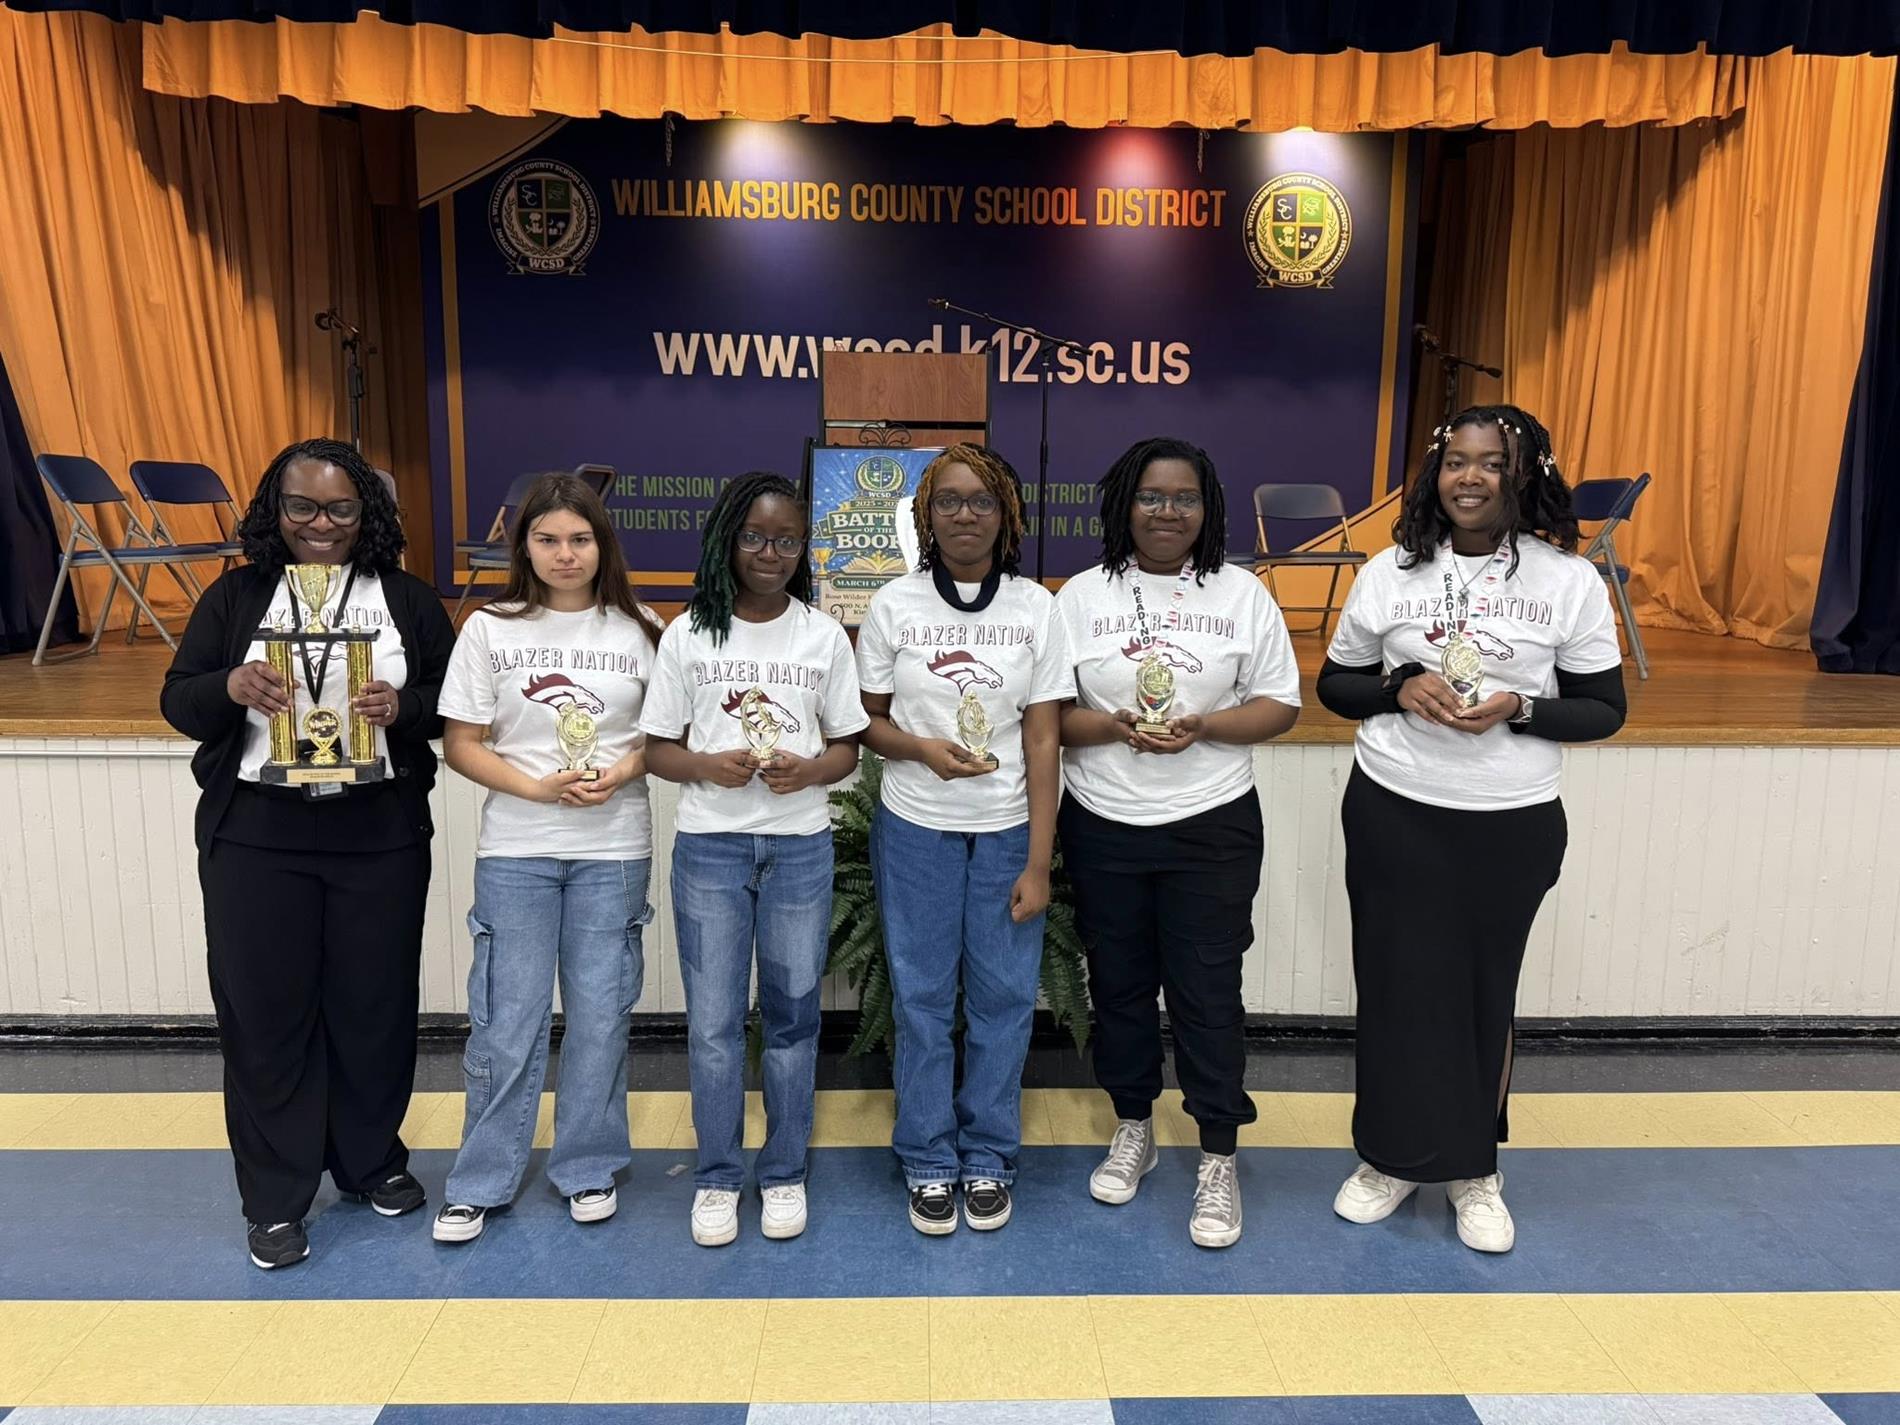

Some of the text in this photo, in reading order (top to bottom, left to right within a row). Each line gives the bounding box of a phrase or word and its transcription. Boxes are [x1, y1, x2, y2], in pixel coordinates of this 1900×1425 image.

[611, 178, 1227, 228] WILLIAMSBURG COUNTY SCHOOL DISTRICT
[529, 258, 565, 269] WCSD
[1279, 271, 1314, 282] WCSD
[615, 476, 637, 496] HE
[642, 476, 715, 498] MISSION
[832, 513, 895, 528] BATT
[1051, 516, 1067, 536] IN
[1073, 516, 1084, 536] A
[836, 534, 899, 549] BOOK
[1133, 586, 1150, 645] READING
[1391, 597, 1469, 621] BLAZR
[1443, 573, 1456, 641] READING
[899, 624, 967, 647] BLAZER
[1093, 612, 1161, 637] BLAZR
[490, 648, 639, 677] BLAZER NATION
[695, 660, 759, 686] BLAZER
